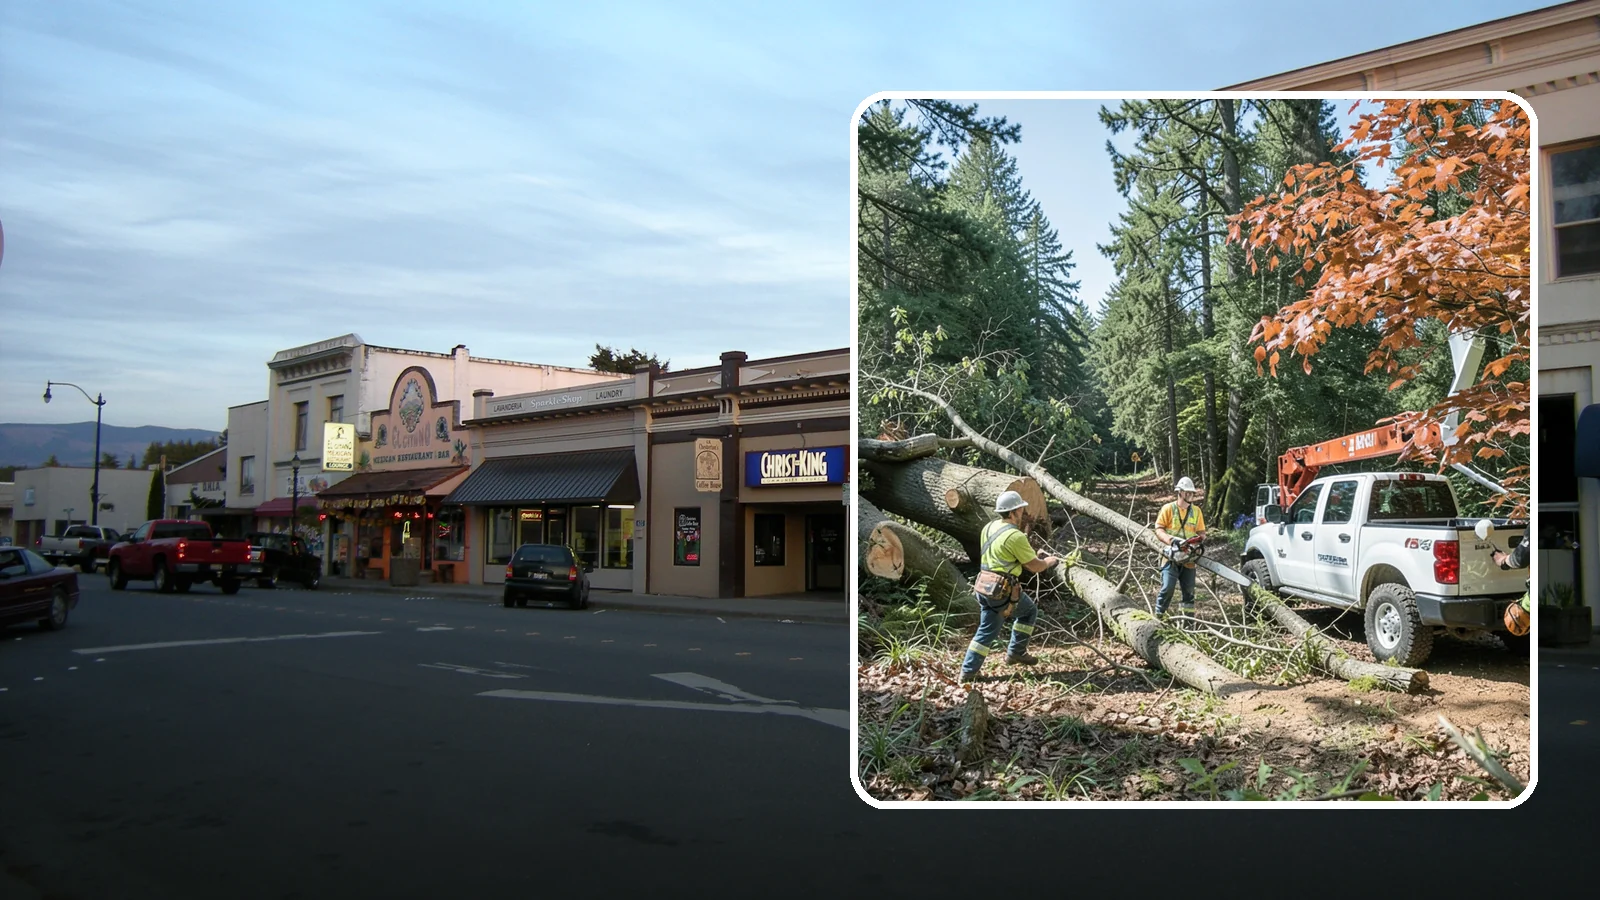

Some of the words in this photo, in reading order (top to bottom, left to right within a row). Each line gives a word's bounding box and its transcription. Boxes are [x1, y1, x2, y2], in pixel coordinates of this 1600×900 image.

[494, 402, 522, 412] LAVANDERIA
[596, 389, 623, 400] LAUNDRY
[373, 454, 396, 463] MEXICAN
[397, 451, 434, 462] RESTAURANT
[438, 450, 450, 459] BAR
[760, 452, 797, 478] CHRIST
[799, 450, 828, 477] KING
